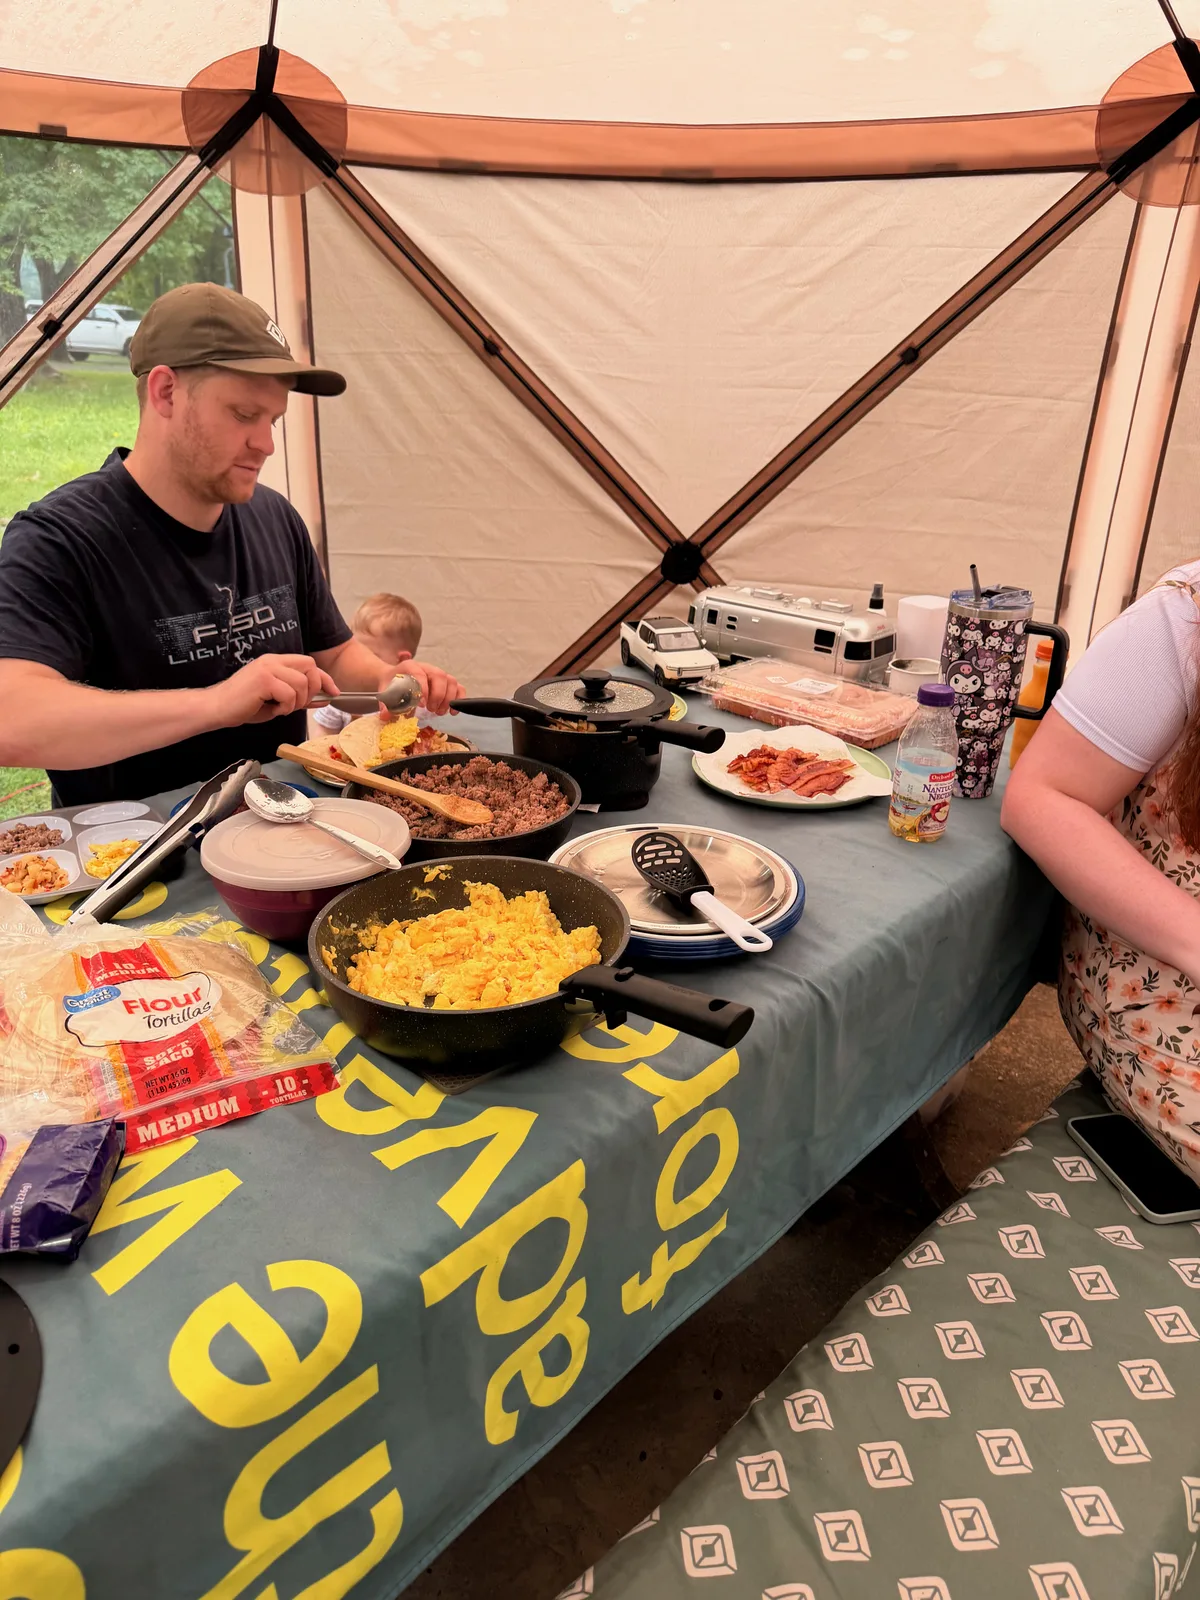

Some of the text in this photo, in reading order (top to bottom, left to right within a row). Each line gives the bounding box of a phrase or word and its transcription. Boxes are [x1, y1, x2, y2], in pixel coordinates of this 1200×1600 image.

[96, 966, 160, 982] MEDIUM
[122, 987, 203, 1015] Flour
[142, 1001, 212, 1029] Tortillas
[143, 1039, 190, 1066] SOFT
[146, 1046, 194, 1071] TACO
[144, 1067, 190, 1089] NET WT 16 OZ
[275, 1075, 297, 1095] 10
[155, 1084, 168, 1095] LB)
[269, 1089, 308, 1105] TORTILLAS
[136, 1095, 241, 1144] MEDIUM
[9, 1224, 21, 1239] WT
